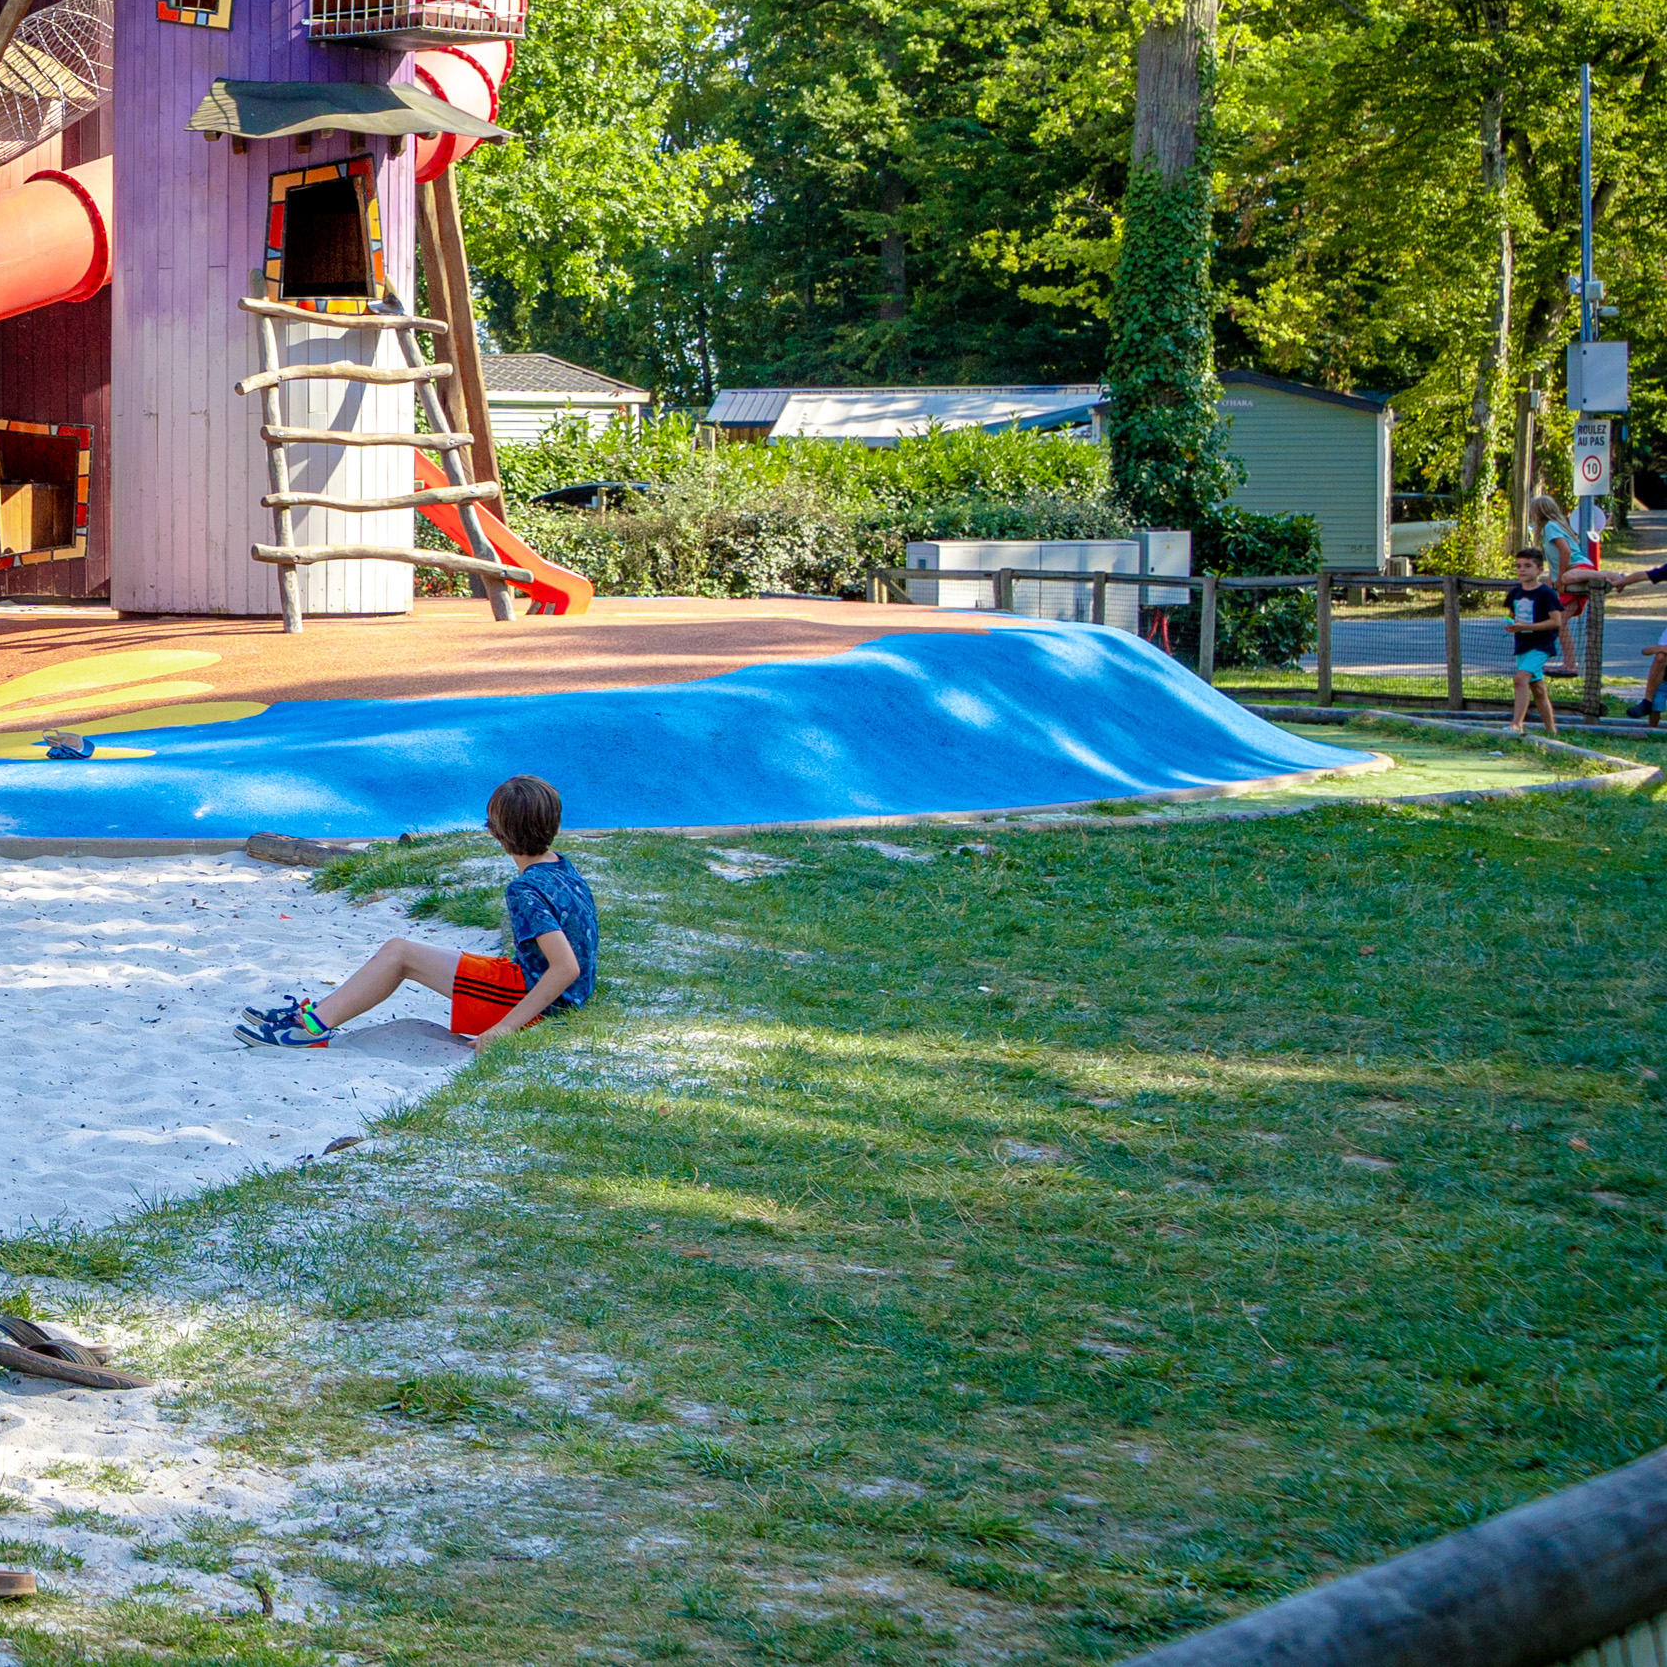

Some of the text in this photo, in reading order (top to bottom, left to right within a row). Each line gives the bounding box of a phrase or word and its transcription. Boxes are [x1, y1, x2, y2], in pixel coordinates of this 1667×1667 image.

[1577, 424, 1607, 435] ROULEZ
[1577, 436, 1605, 447] AU PAS
[1586, 462, 1598, 475] 10
